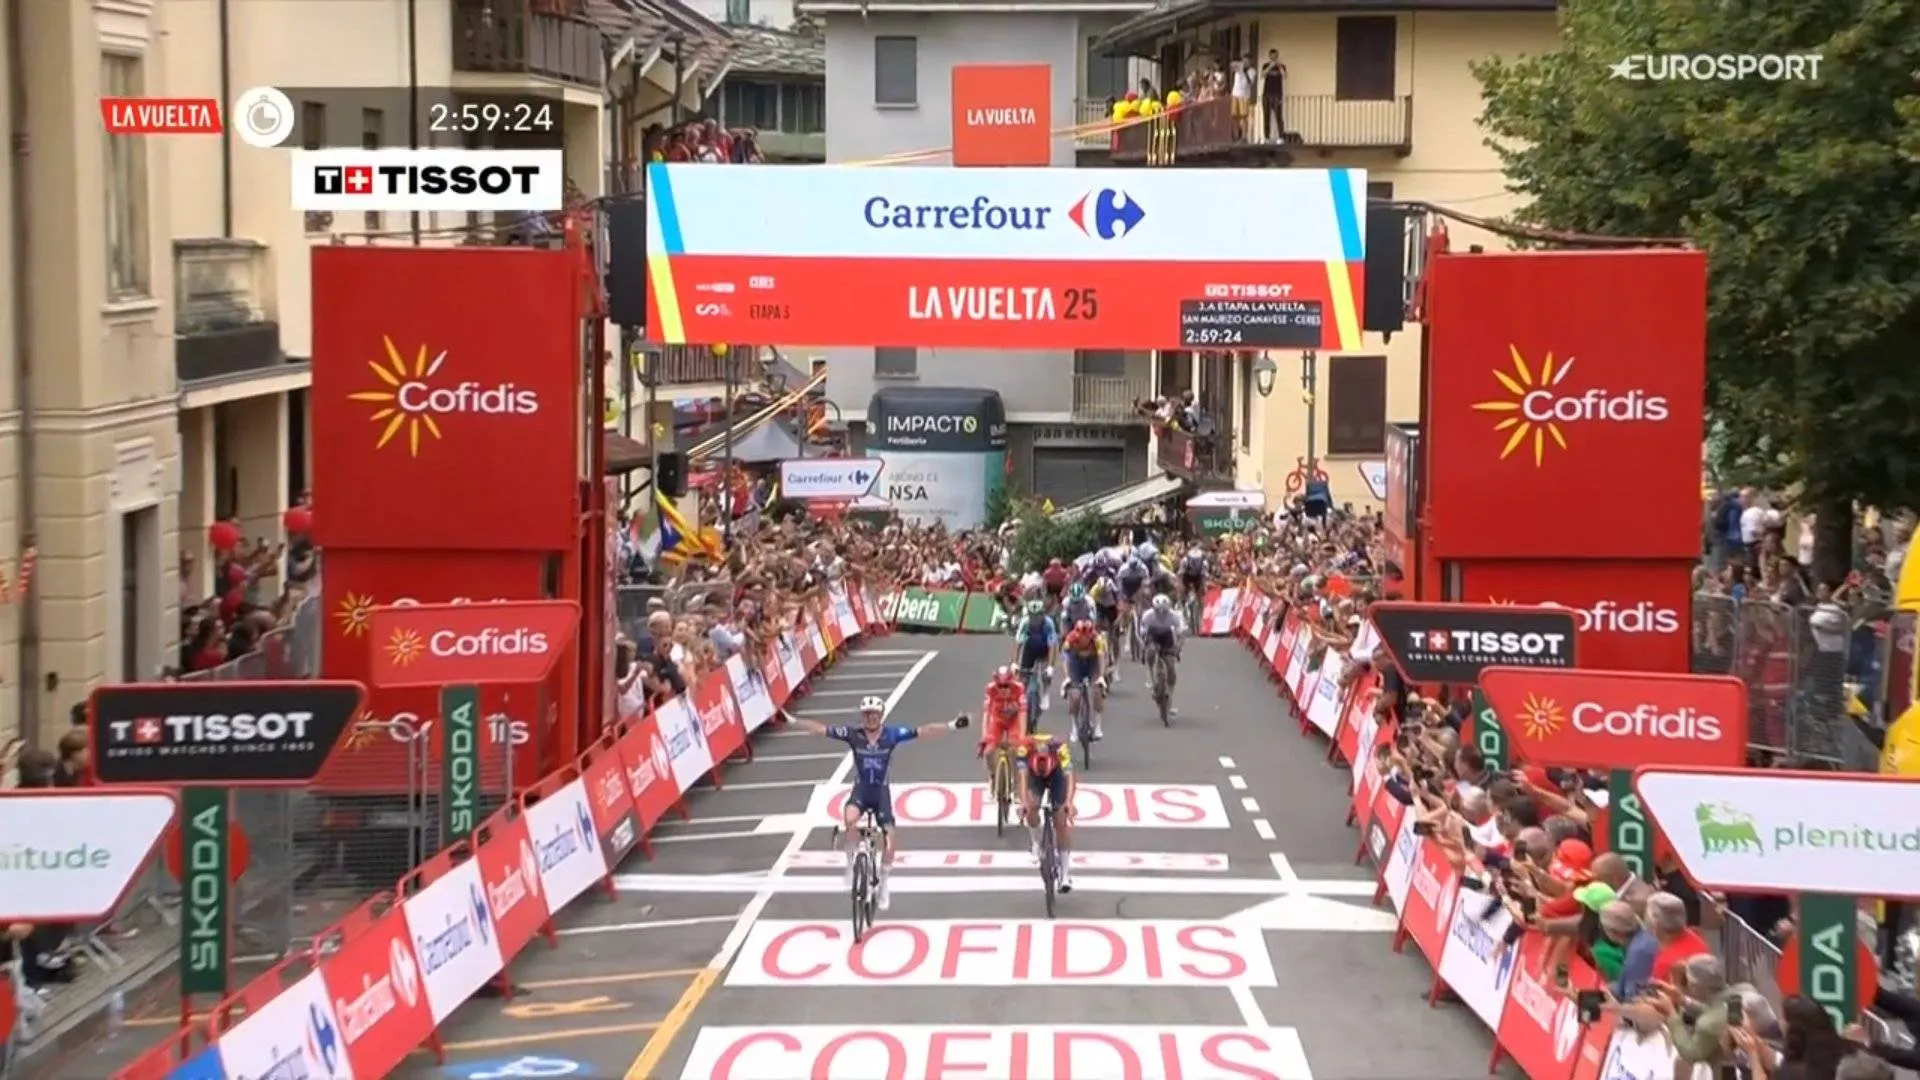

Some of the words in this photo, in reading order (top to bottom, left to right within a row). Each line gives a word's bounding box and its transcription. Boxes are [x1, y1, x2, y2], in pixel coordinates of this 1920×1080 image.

[967, 109, 985, 126] LA
[986, 109, 1036, 126] VUELTA
[864, 196, 1051, 229] Carrefour
[908, 285, 943, 320] LA
[948, 286, 1056, 321] VUELTA
[1063, 288, 1098, 320] 25
[1231, 284, 1293, 297] TISSOT
[1217, 302, 1250, 312] ETAPA
[1251, 302, 1267, 312] LA
[1267, 302, 1306, 312] VUELTA
[1185, 328, 1243, 344] 2:59:24
[398, 381, 539, 414] Cofidis
[1522, 388, 1669, 422] Cofidis
[887, 415, 978, 433] IMPACTO
[787, 473, 843, 485] Carrefour
[888, 485, 929, 501] NSA
[430, 627, 549, 657] Cofidis
[1451, 630, 1565, 655] TISSOT
[164, 711, 314, 743] TISSOT
[1572, 701, 1722, 742] Cofidis
[760, 923, 1248, 981] COFIDIS
[708, 1030, 1282, 1080] COFIDIS
